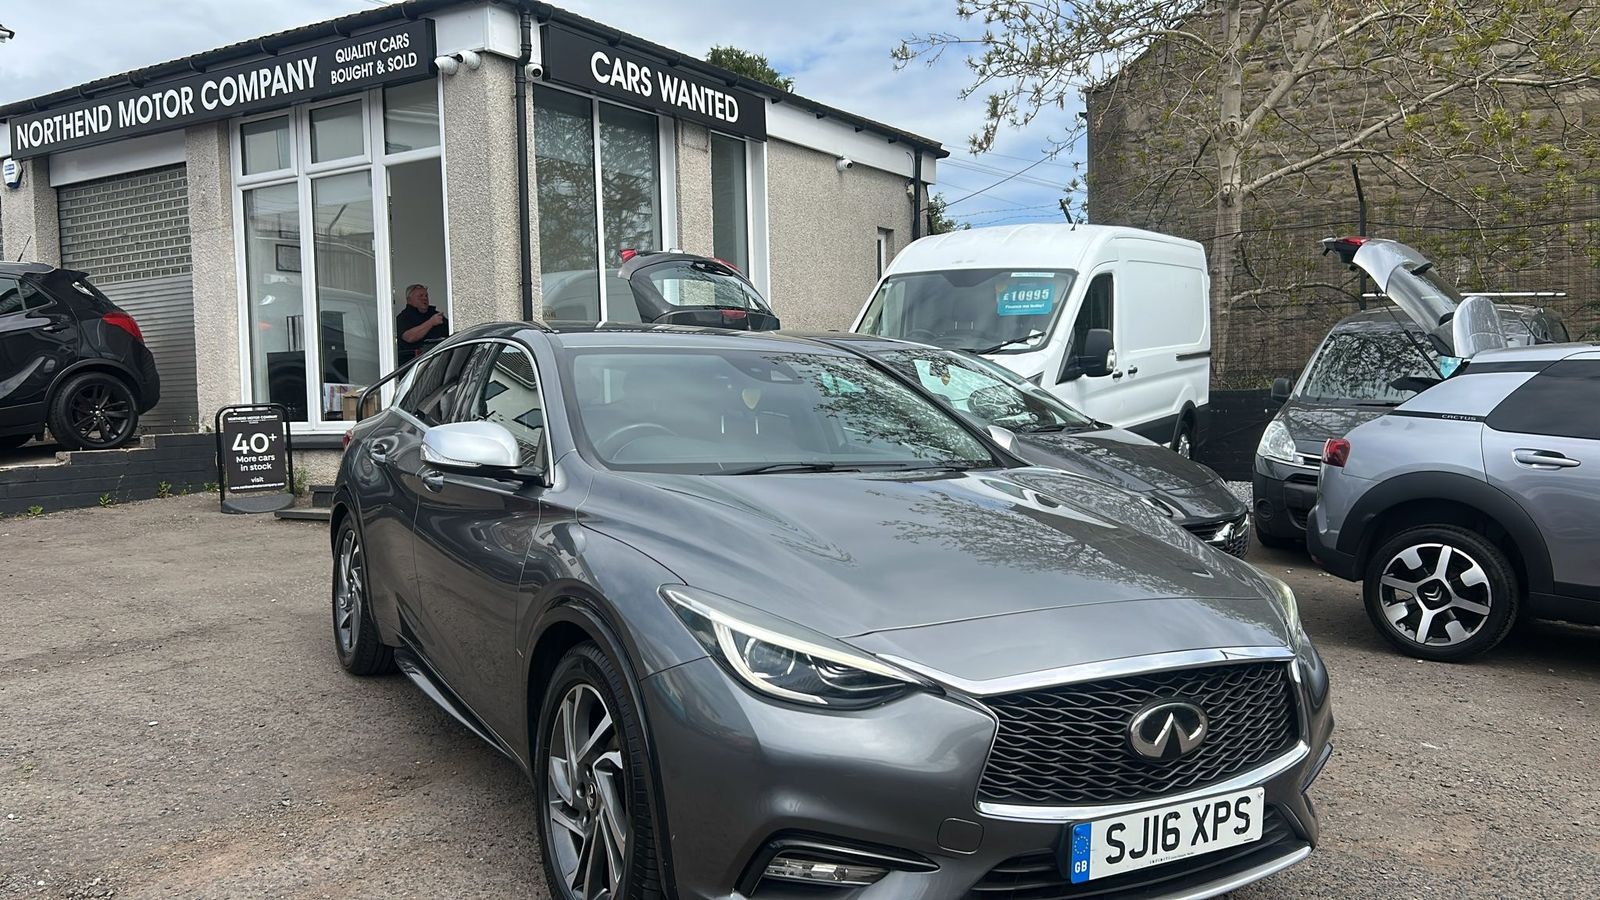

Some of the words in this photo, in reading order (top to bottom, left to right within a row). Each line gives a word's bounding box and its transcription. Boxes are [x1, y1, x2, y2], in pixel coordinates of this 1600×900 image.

[335, 40, 377, 63] QUALITY
[380, 32, 410, 53] CARS
[330, 61, 374, 85] BOUGHT
[376, 60, 386, 75] &
[387, 52, 418, 72] SOLD
[590, 51, 652, 97] CARS
[657, 71, 739, 123] WANTED
[16, 104, 112, 150] NORTHEND
[118, 86, 194, 129] MOTOR
[200, 56, 318, 111] COMPANY
[1003, 289, 1049, 301] £10995
[236, 456, 257, 464] More
[258, 454, 275, 462] cars
[249, 463, 272, 471] stock
[1105, 811, 1181, 865] SJ16
[1190, 796, 1251, 846] XPS
[1074, 860, 1088, 874] GB
